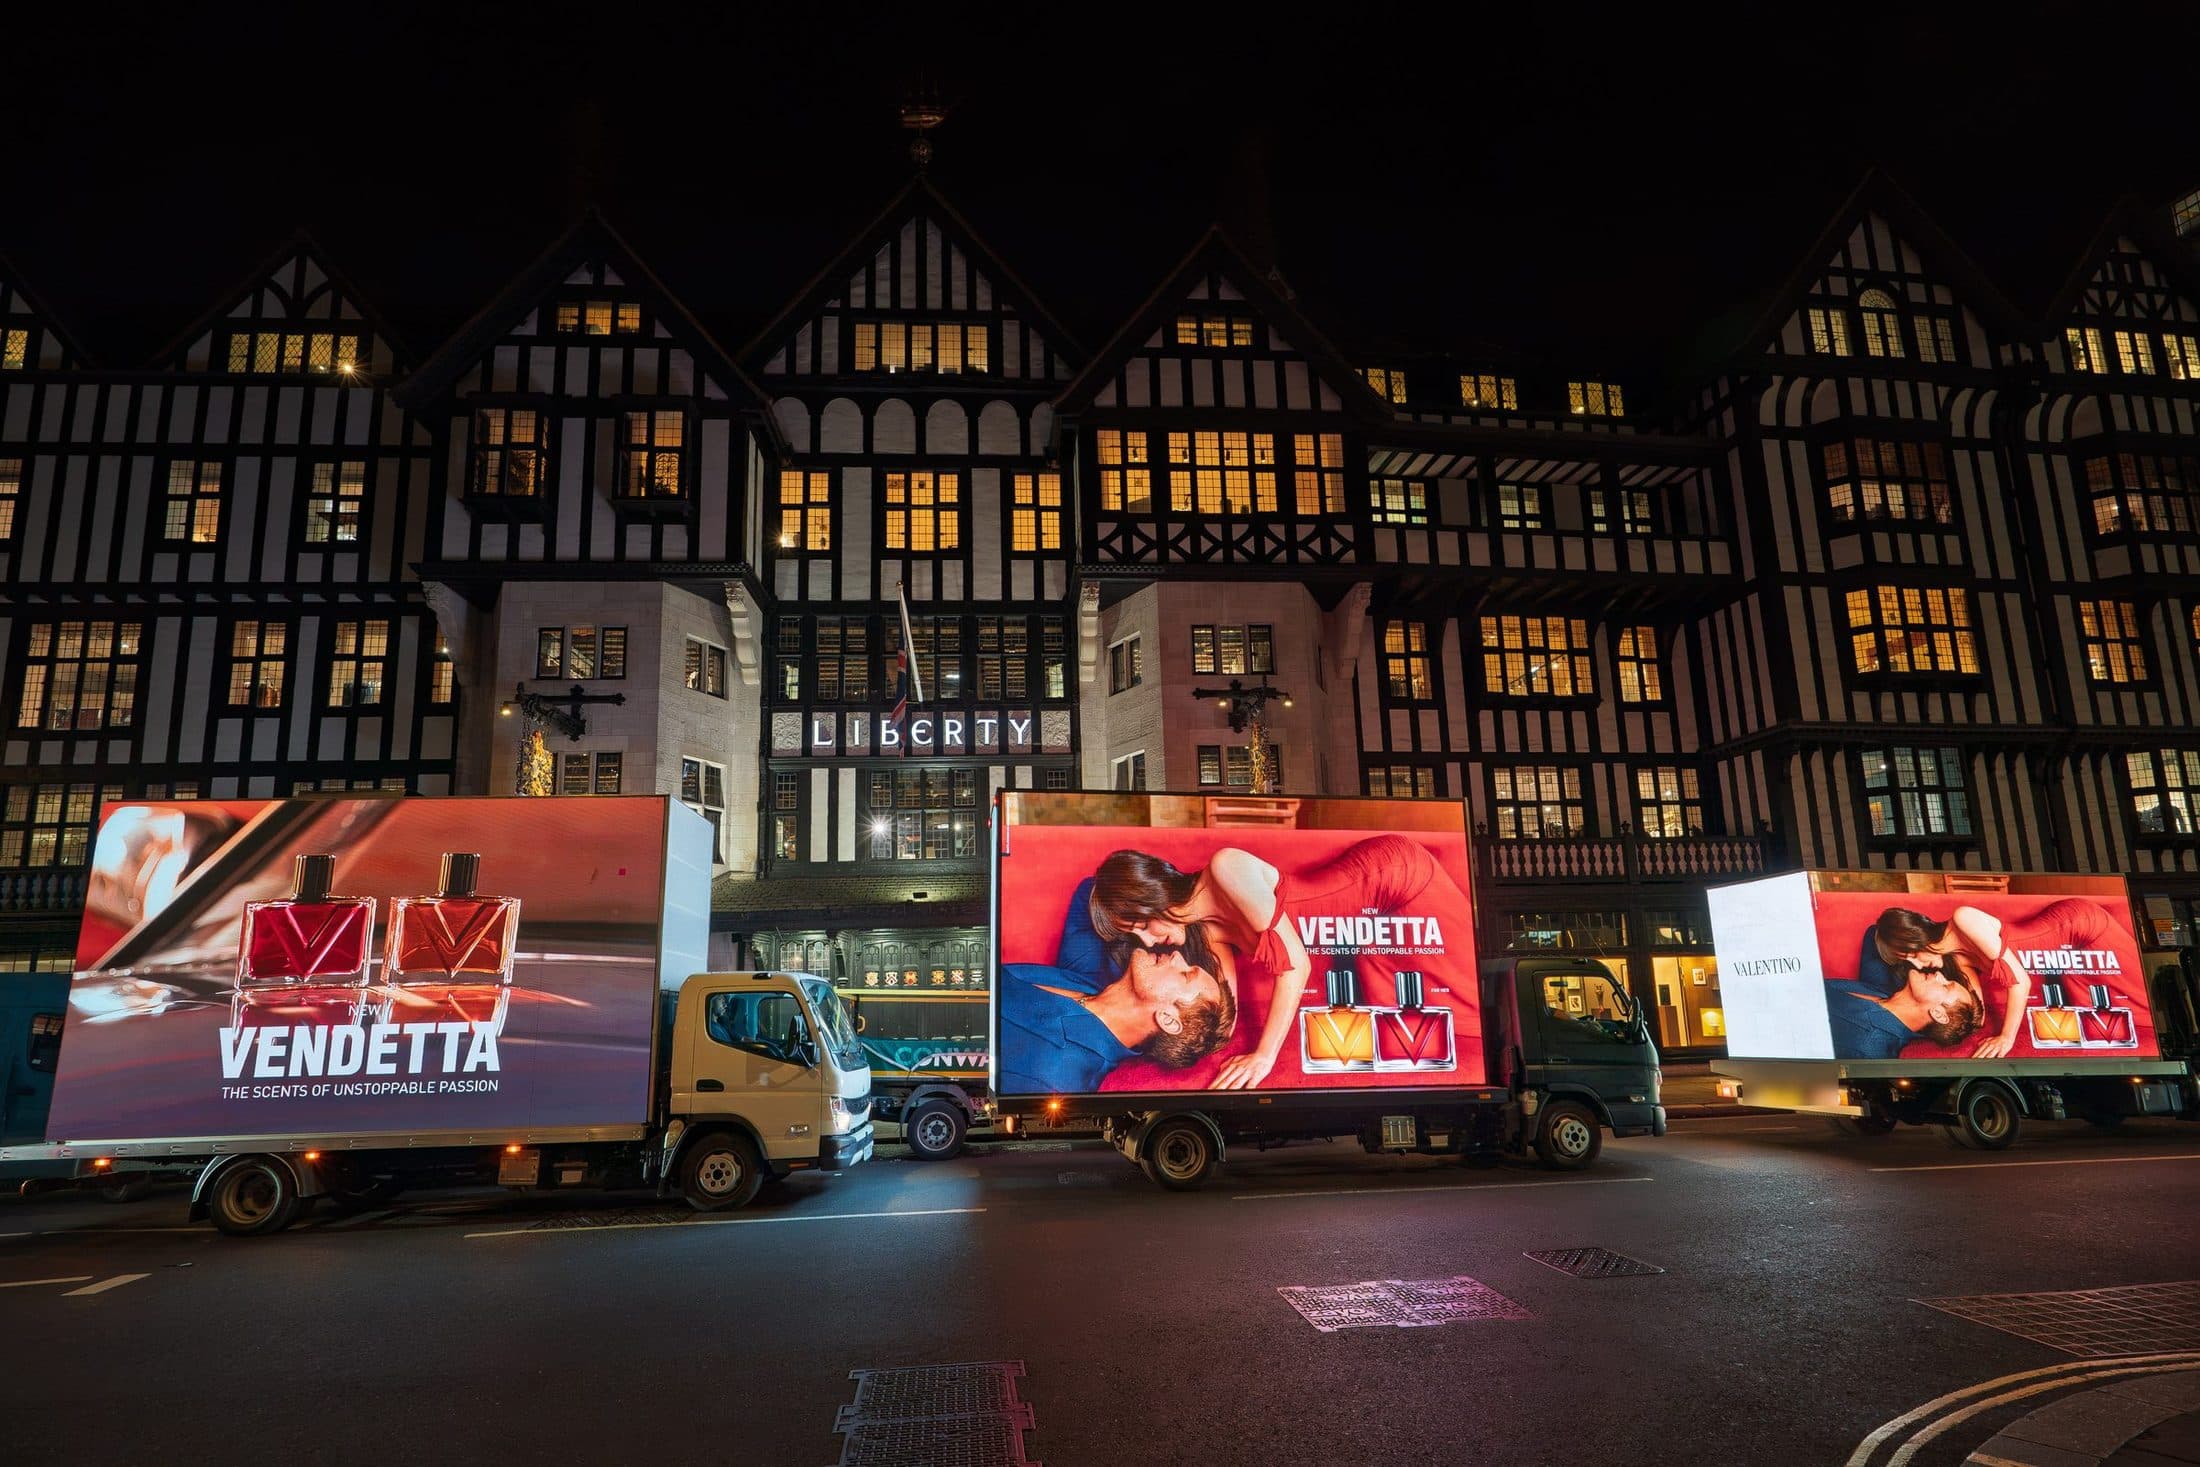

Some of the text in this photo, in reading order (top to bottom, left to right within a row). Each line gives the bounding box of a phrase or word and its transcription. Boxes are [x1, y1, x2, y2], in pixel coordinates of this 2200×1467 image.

[813, 718, 1031, 746] LIBERTY
[1361, 907, 1379, 915] NEW
[1298, 916, 1444, 945] VENDETTA
[1305, 947, 1445, 955] THE SCENTS OF UNSTOPPABLE PASSION
[2017, 950, 2121, 968] VENDETTA
[1733, 956, 1802, 977] VALENTINO
[348, 1003, 382, 1017] NEW
[219, 1021, 500, 1079] VENDETTA
[222, 1078, 499, 1099] THE SCENTS OF UNSTOPPABLE PASSION
